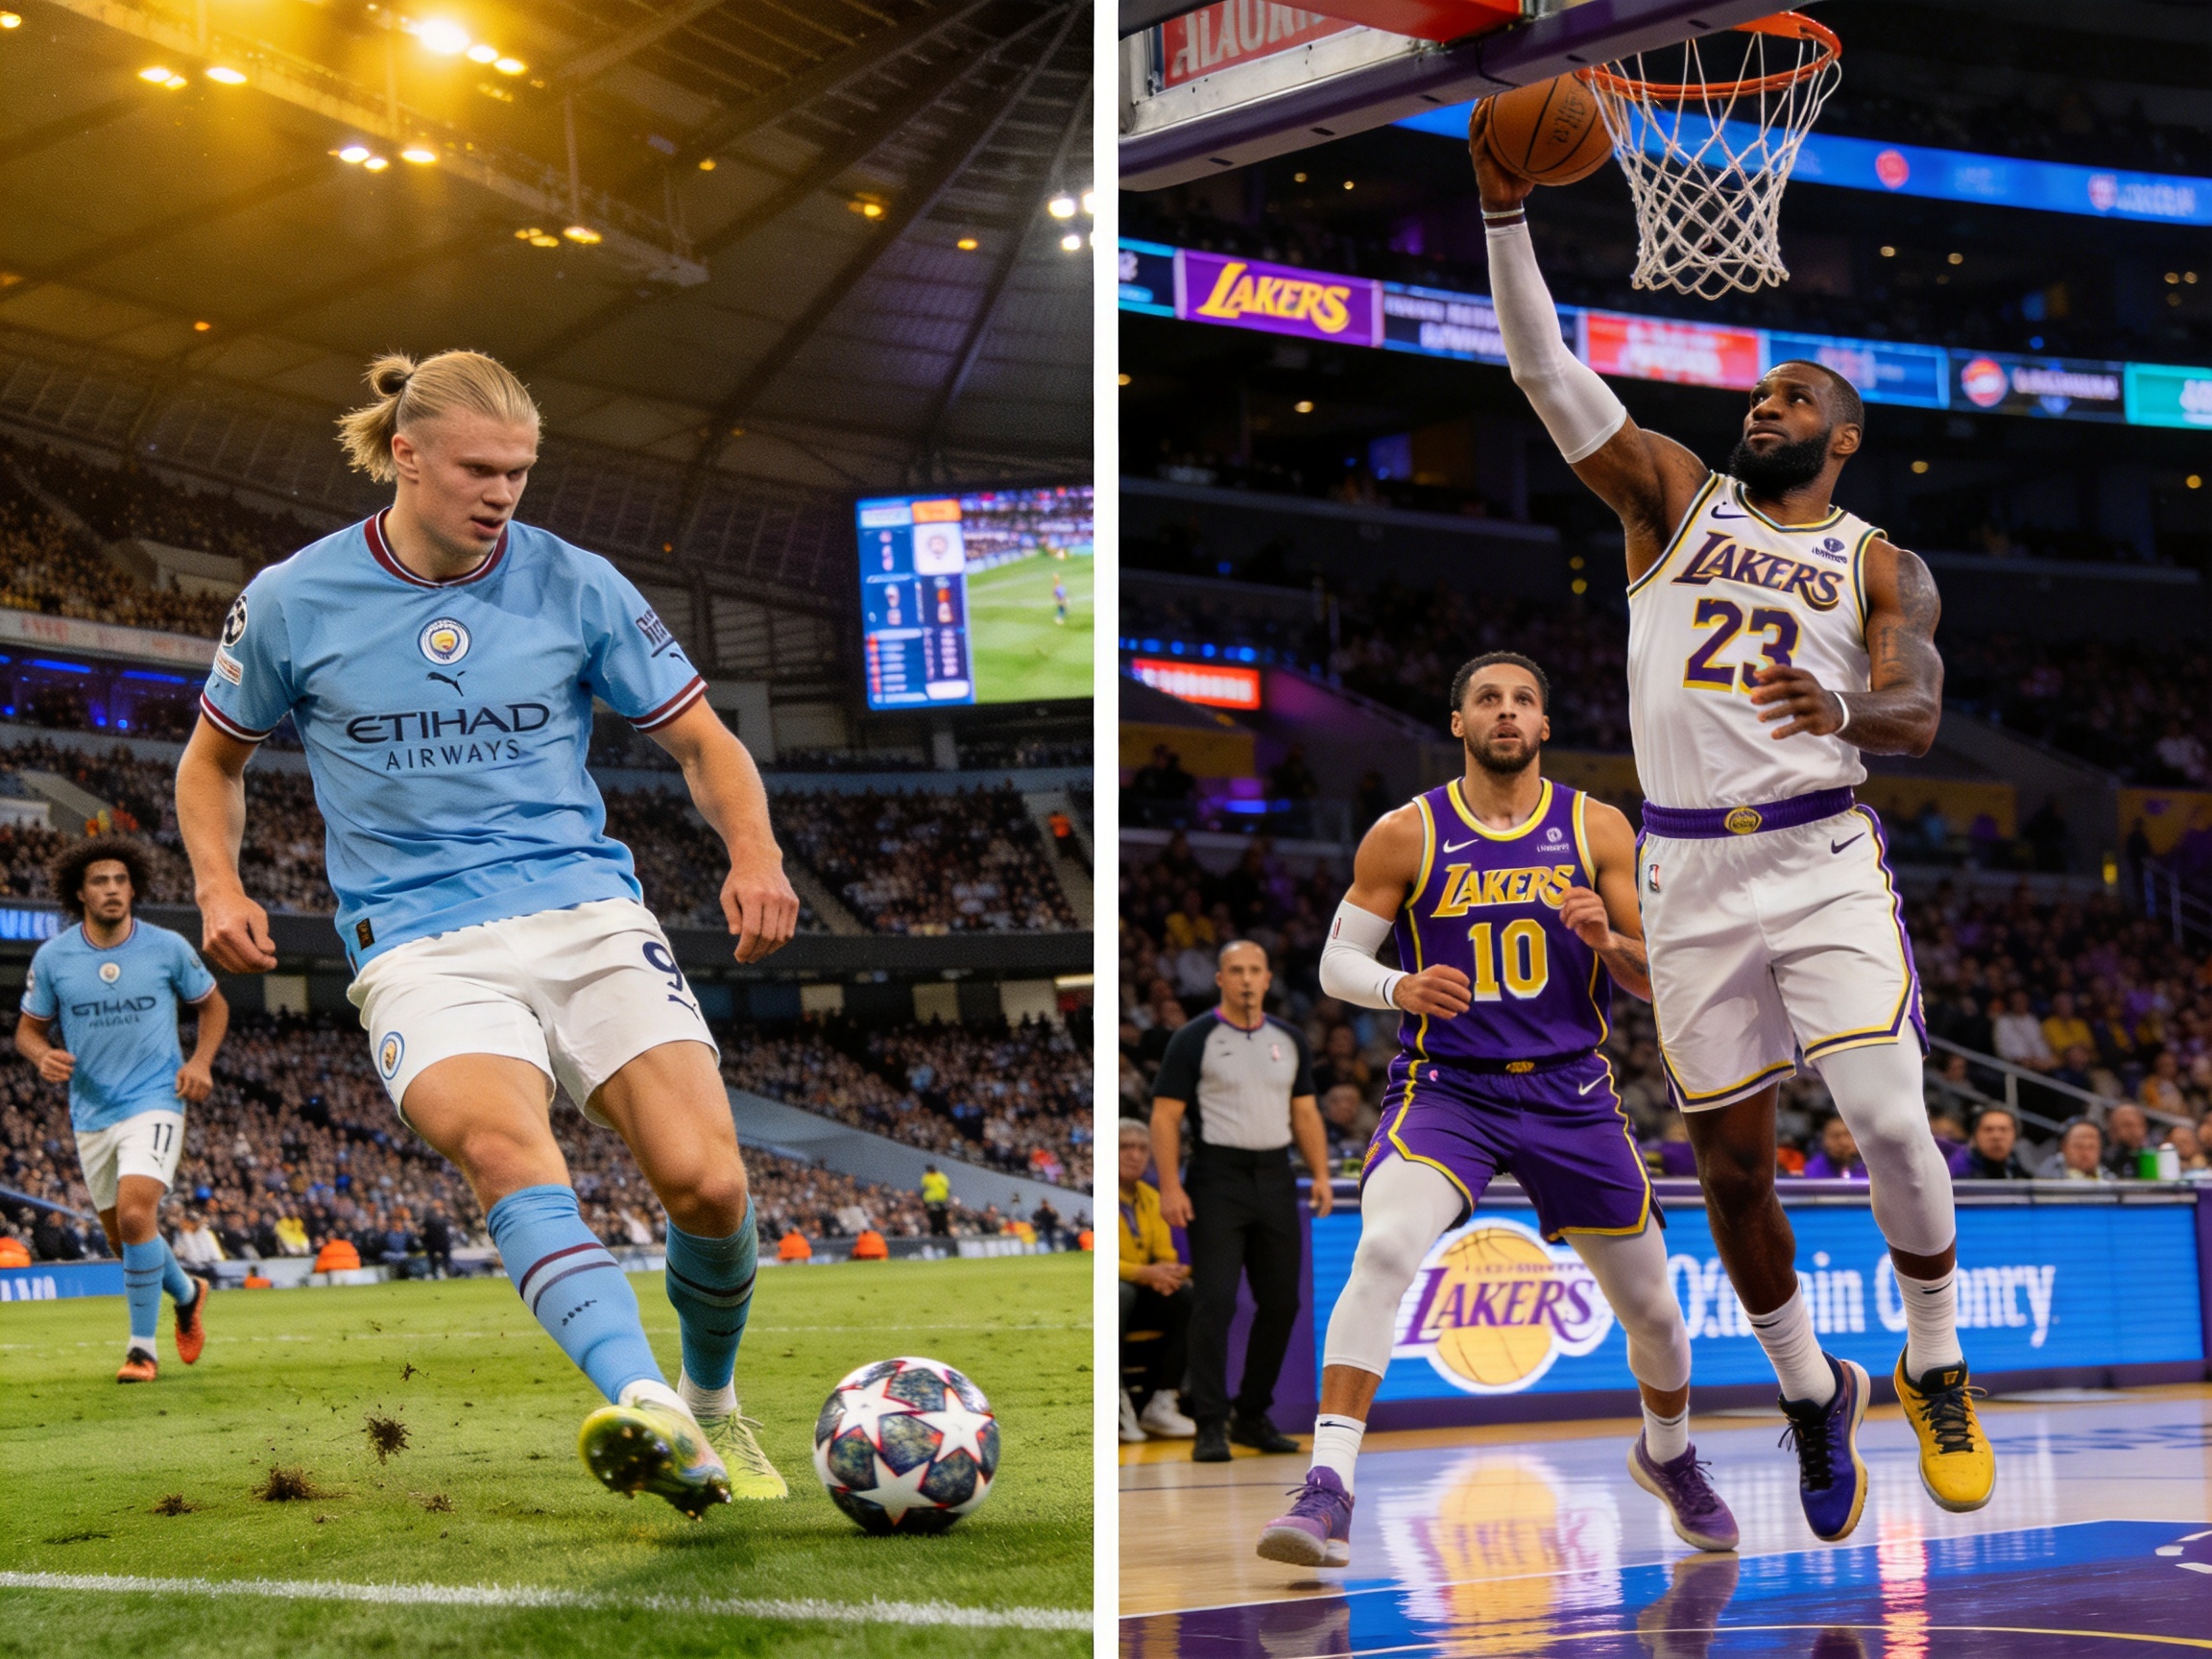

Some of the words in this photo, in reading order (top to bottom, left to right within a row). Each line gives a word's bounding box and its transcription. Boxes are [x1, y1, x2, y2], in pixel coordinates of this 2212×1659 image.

[1196, 261, 1351, 333] LAKERS
[1671, 530, 1845, 613] LAKERS
[1683, 597, 1802, 695] 23
[347, 703, 550, 744] ETIHAD
[386, 738, 520, 771] AIRWAYS
[1430, 863, 1575, 918] LAKERS
[641, 941, 683, 992] 9
[1468, 919, 1549, 1001] 10
[152, 1122, 173, 1152] 11
[1397, 1267, 1601, 1346] LAKERS
